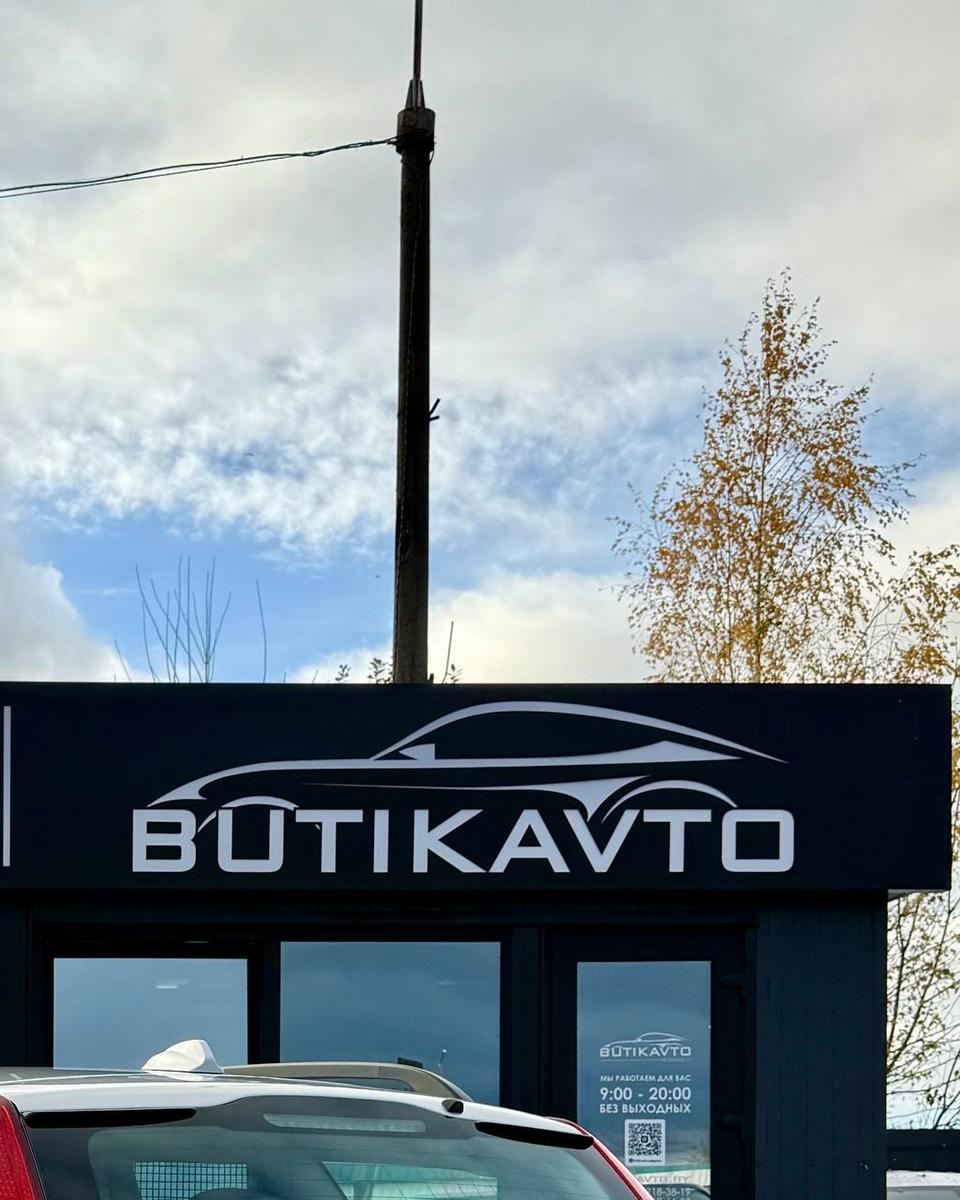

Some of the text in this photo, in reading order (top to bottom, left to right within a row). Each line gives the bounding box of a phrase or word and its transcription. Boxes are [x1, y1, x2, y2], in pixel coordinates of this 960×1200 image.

[131, 808, 795, 874] BUTIKAVTO
[600, 1046, 692, 1057] BUTIKAVTO
[600, 1087, 633, 1100] 9:00
[649, 1087, 692, 1100] 20:00
[600, 1103, 691, 1114] БЕЗ ВЫХОДНЫХ
